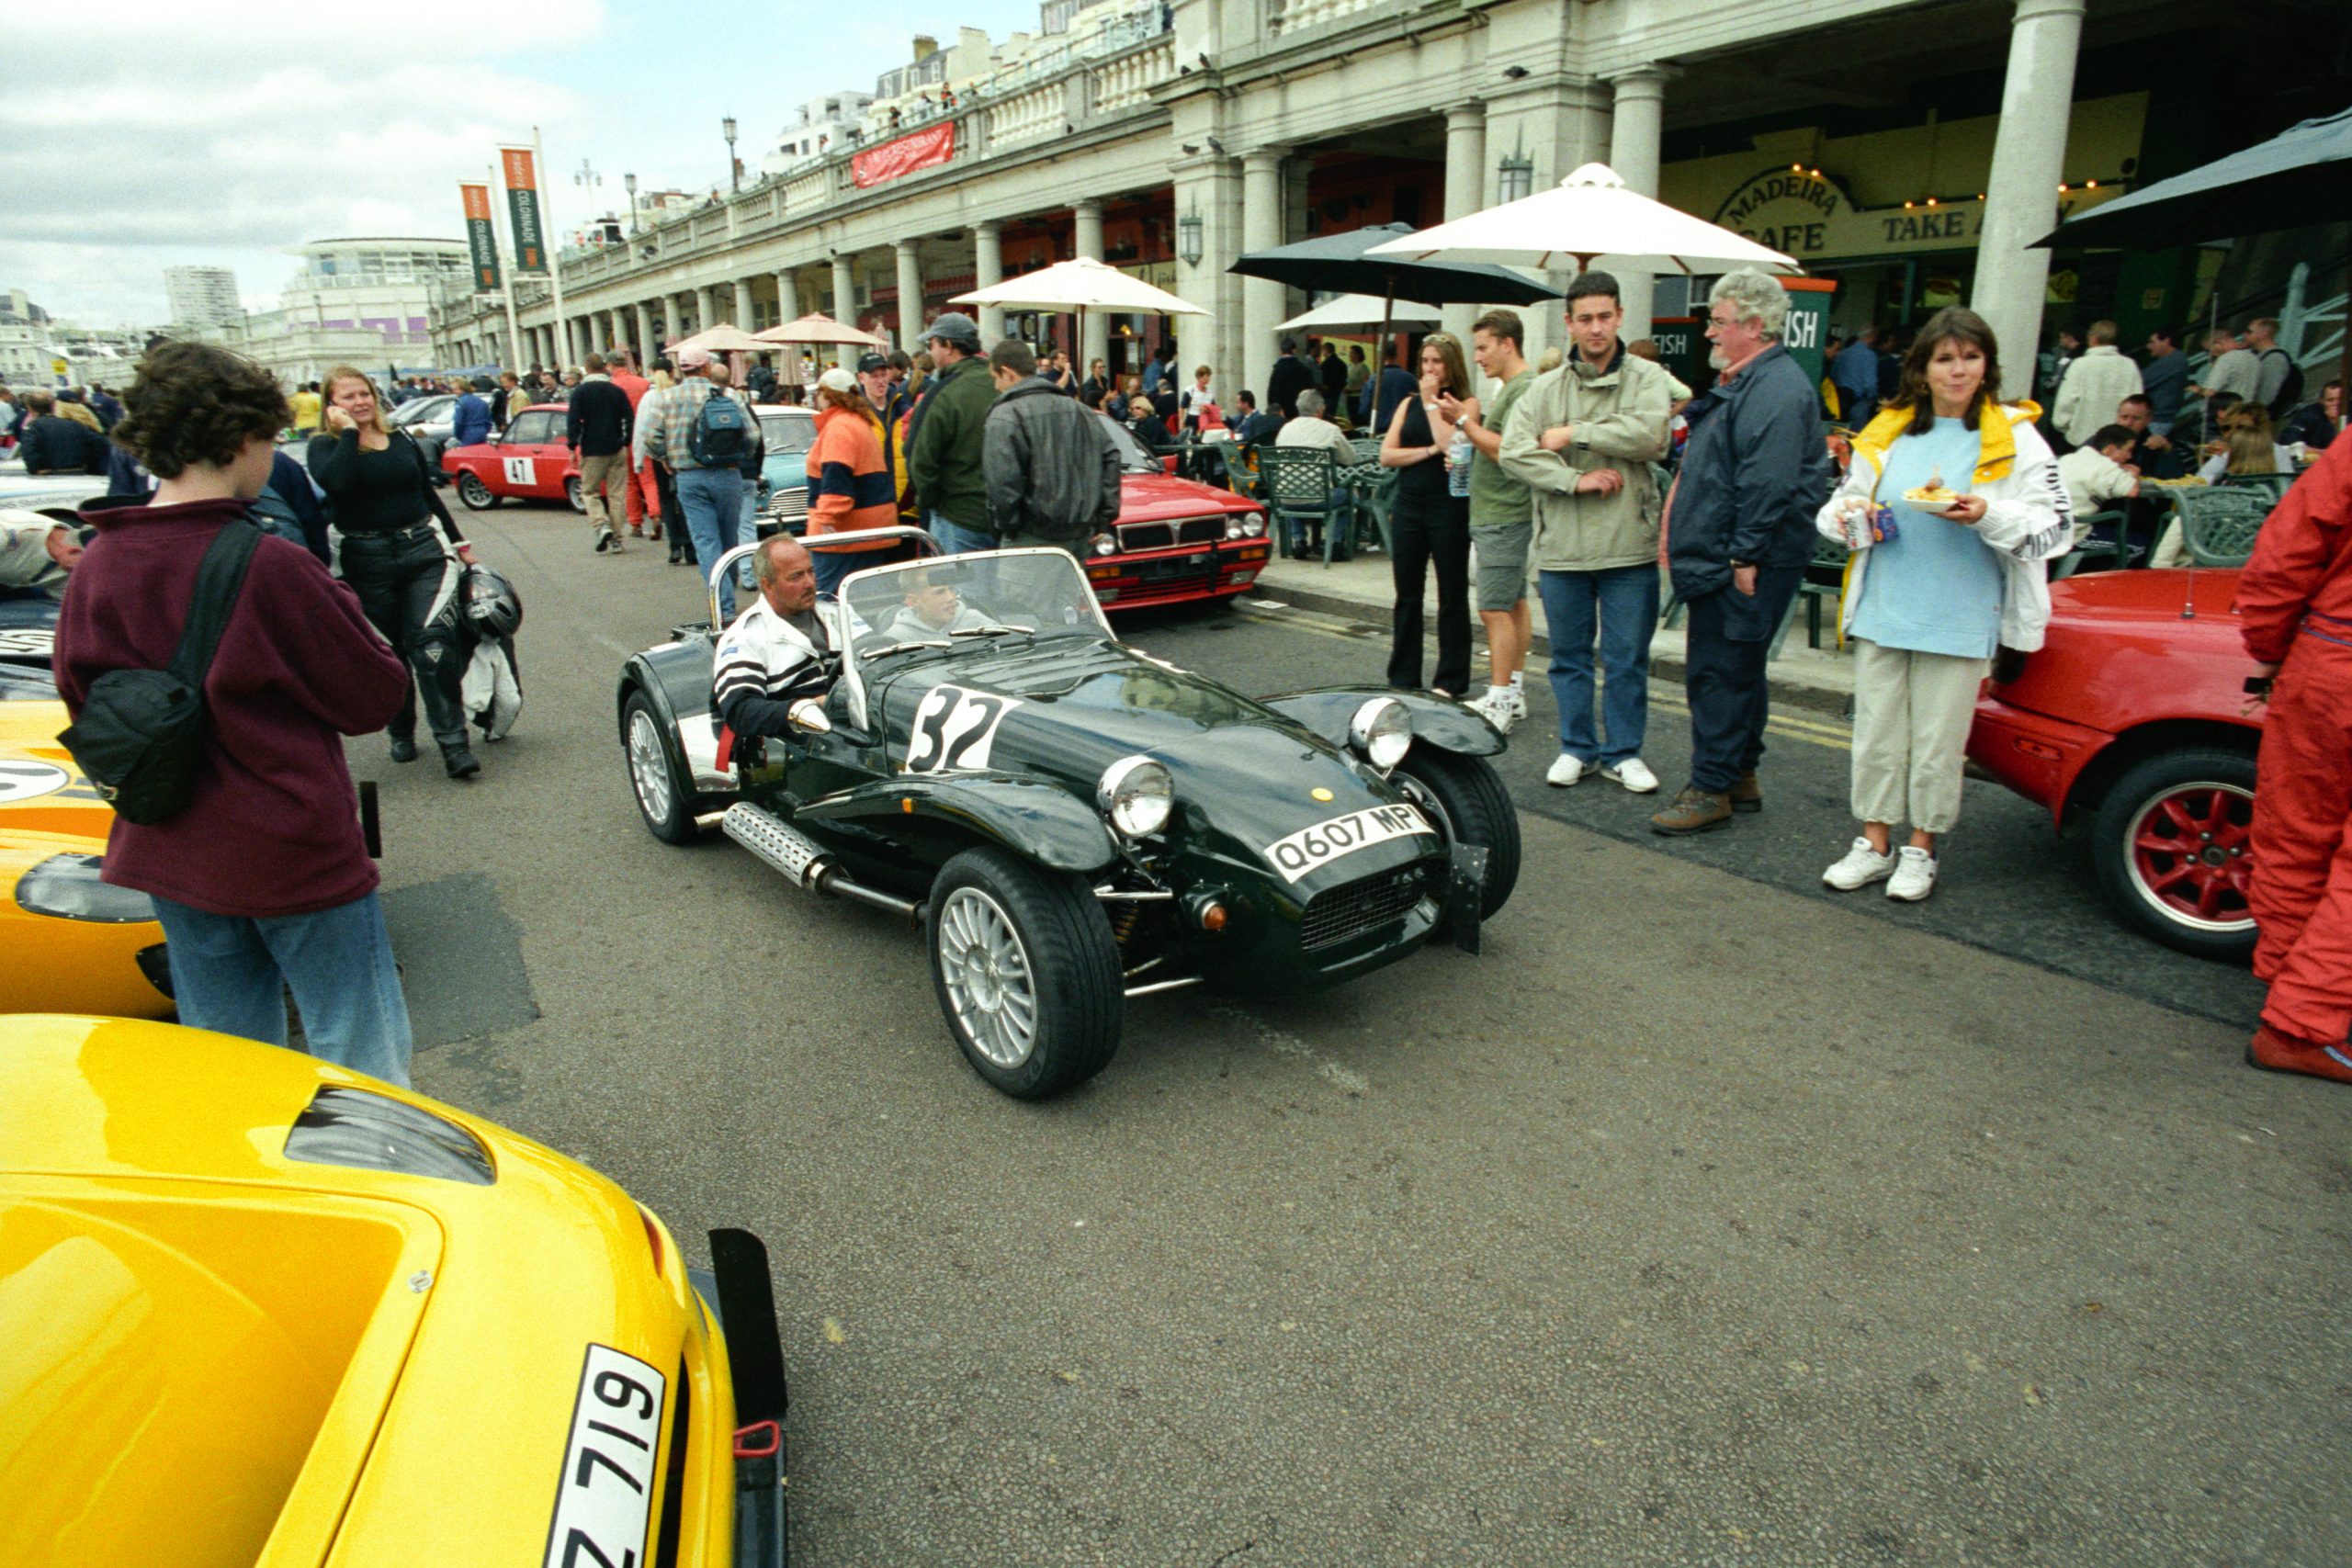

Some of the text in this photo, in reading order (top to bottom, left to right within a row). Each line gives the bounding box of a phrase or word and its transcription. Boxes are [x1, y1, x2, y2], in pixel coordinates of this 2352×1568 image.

[516, 190, 536, 243] COLONNADE
[1728, 175, 1838, 225] MADEIRA
[1883, 211, 1964, 243] TAKE
[1652, 333, 1687, 355] FISH
[1782, 310, 1818, 348] ISH
[509, 459, 526, 483] 47
[908, 686, 1004, 773] 32
[1274, 815, 1366, 871] Q607
[575, 1370, 654, 1495] 719
